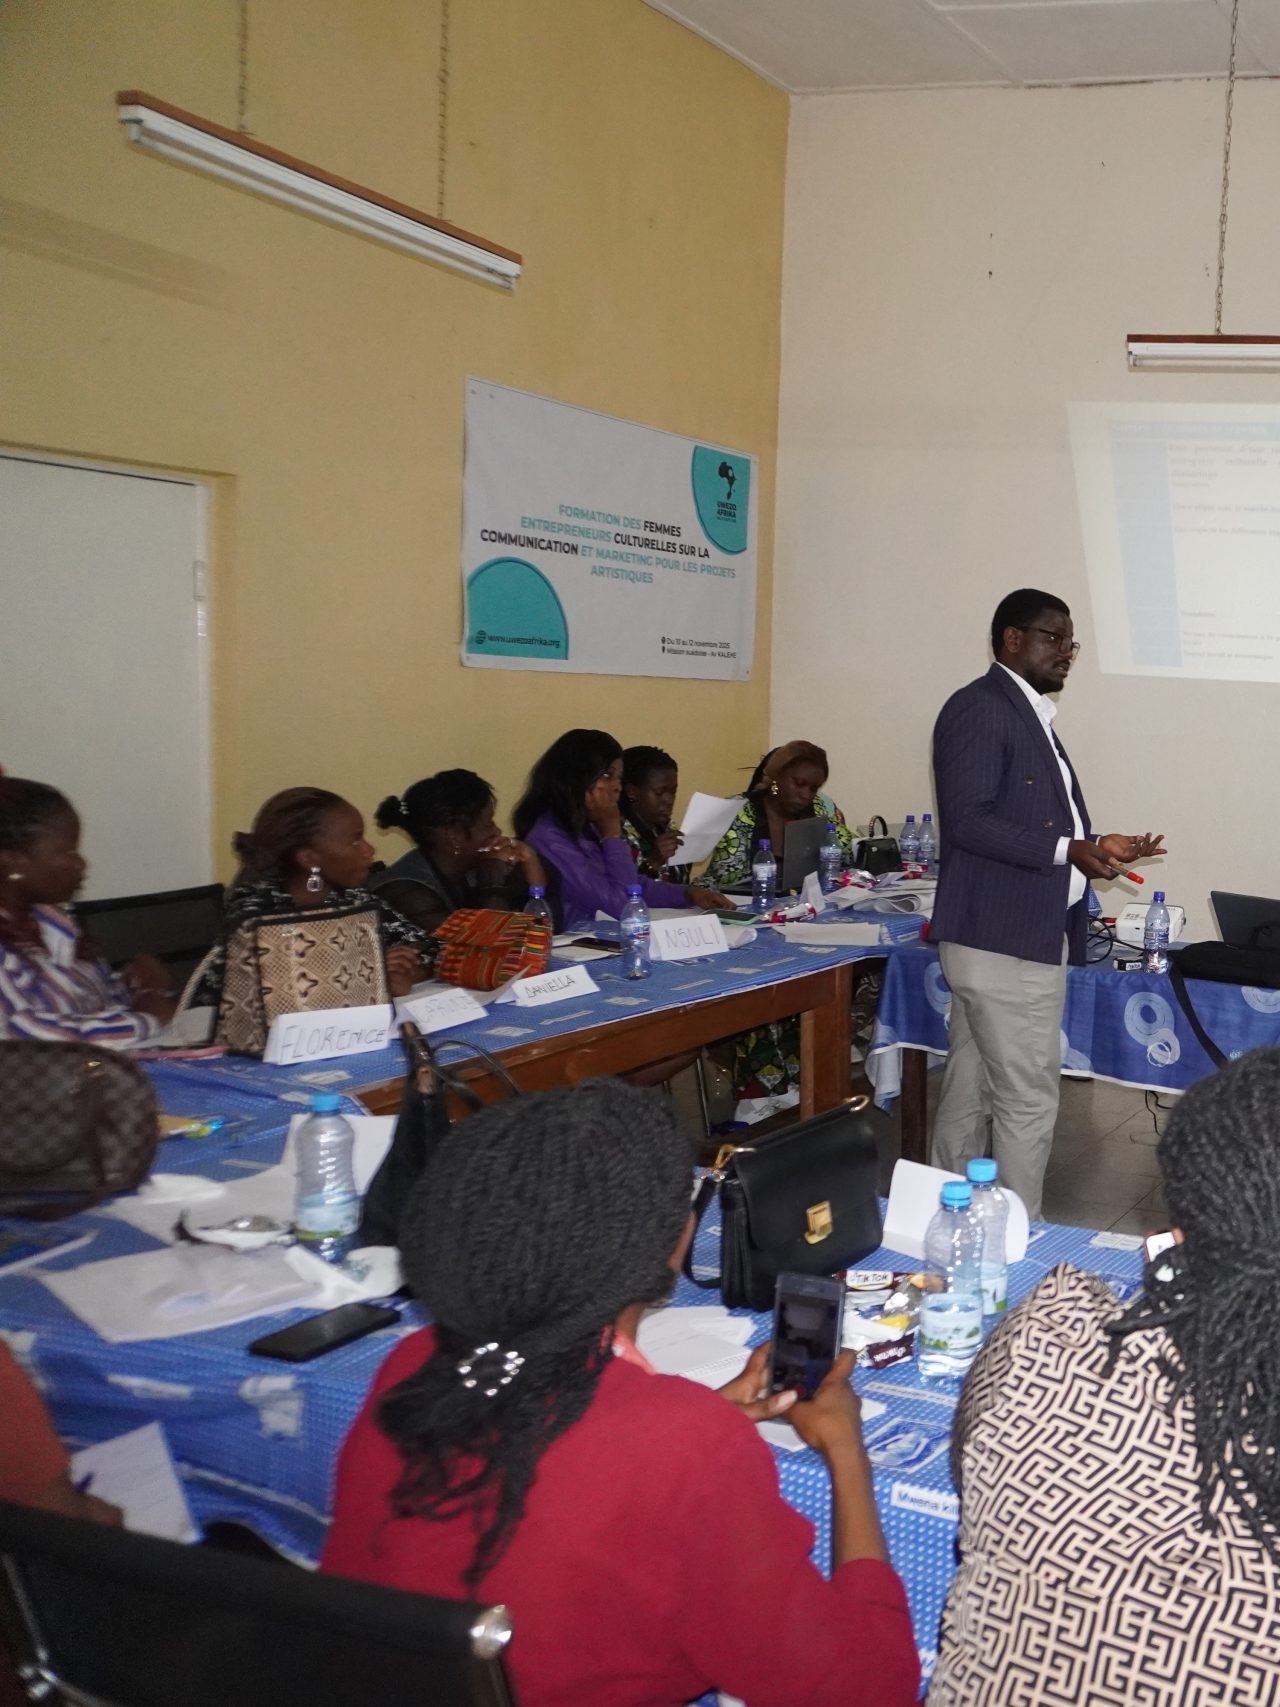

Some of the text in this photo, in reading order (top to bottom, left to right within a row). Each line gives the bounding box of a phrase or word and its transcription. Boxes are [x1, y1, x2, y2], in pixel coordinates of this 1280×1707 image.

[520, 516, 710, 559] ENTREPRENEURS CULTURELLES SUR LA
[558, 503, 682, 537] FORMATION DES FEMMES
[480, 528, 737, 579] COMMUNICATION ET MARKETING POUR LES PROJETS
[590, 564, 654, 584] ARTISTIQUES
[525, 975, 576, 998] DANIELLA
[280, 1024, 387, 1062] FLORENCE
